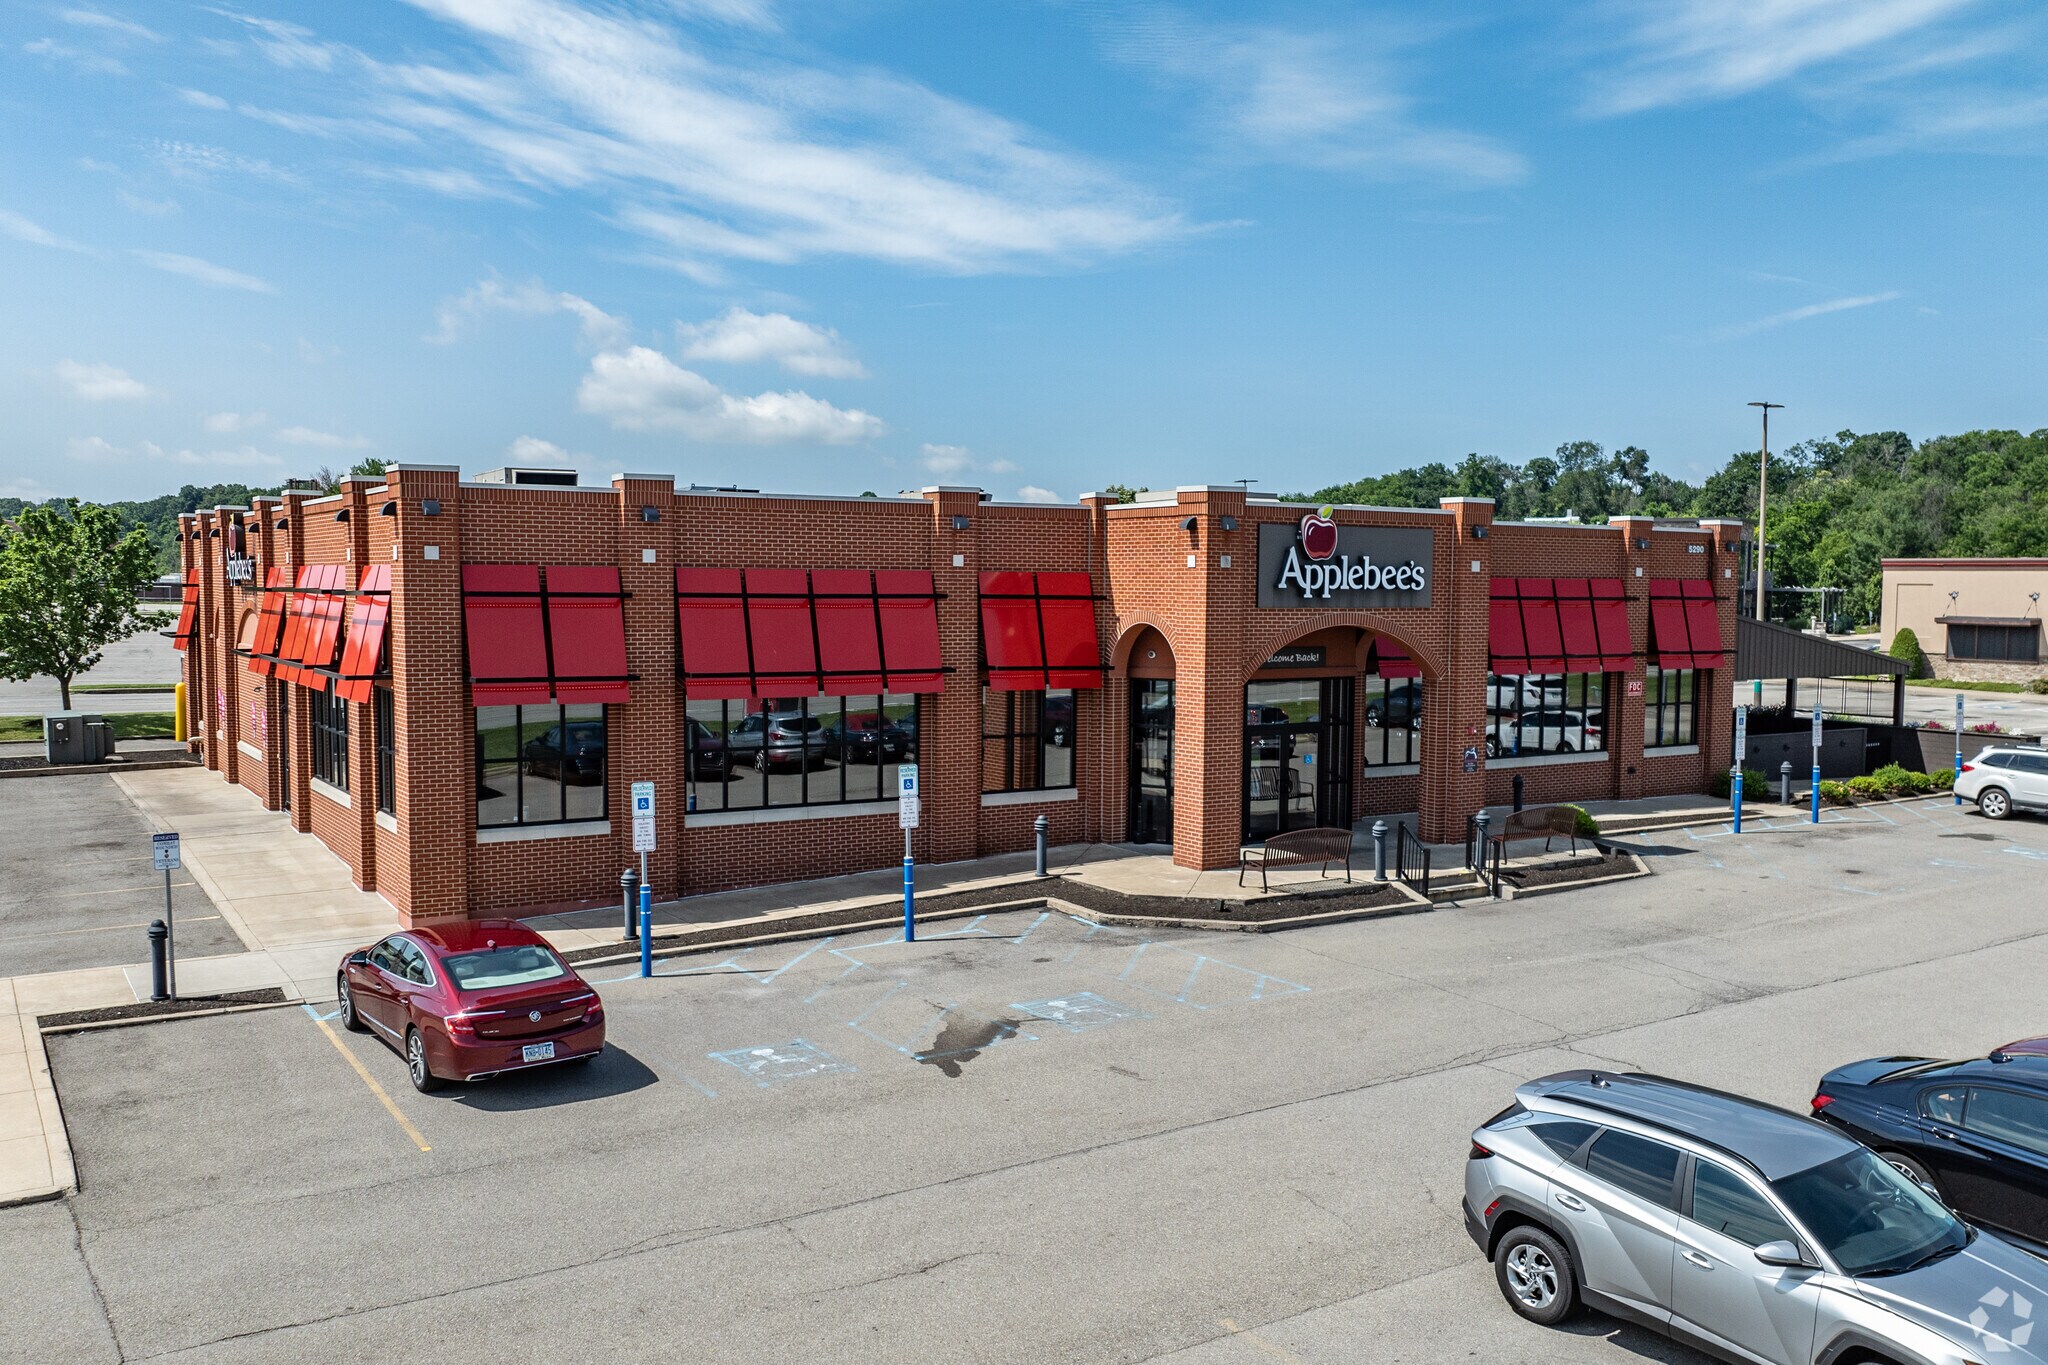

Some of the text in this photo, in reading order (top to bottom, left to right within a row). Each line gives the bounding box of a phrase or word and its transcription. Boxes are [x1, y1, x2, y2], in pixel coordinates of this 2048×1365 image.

[1688, 545, 1704, 553] 5290
[1278, 546, 1425, 598] Applebee's
[1264, 652, 1319, 662] elcome Back!
